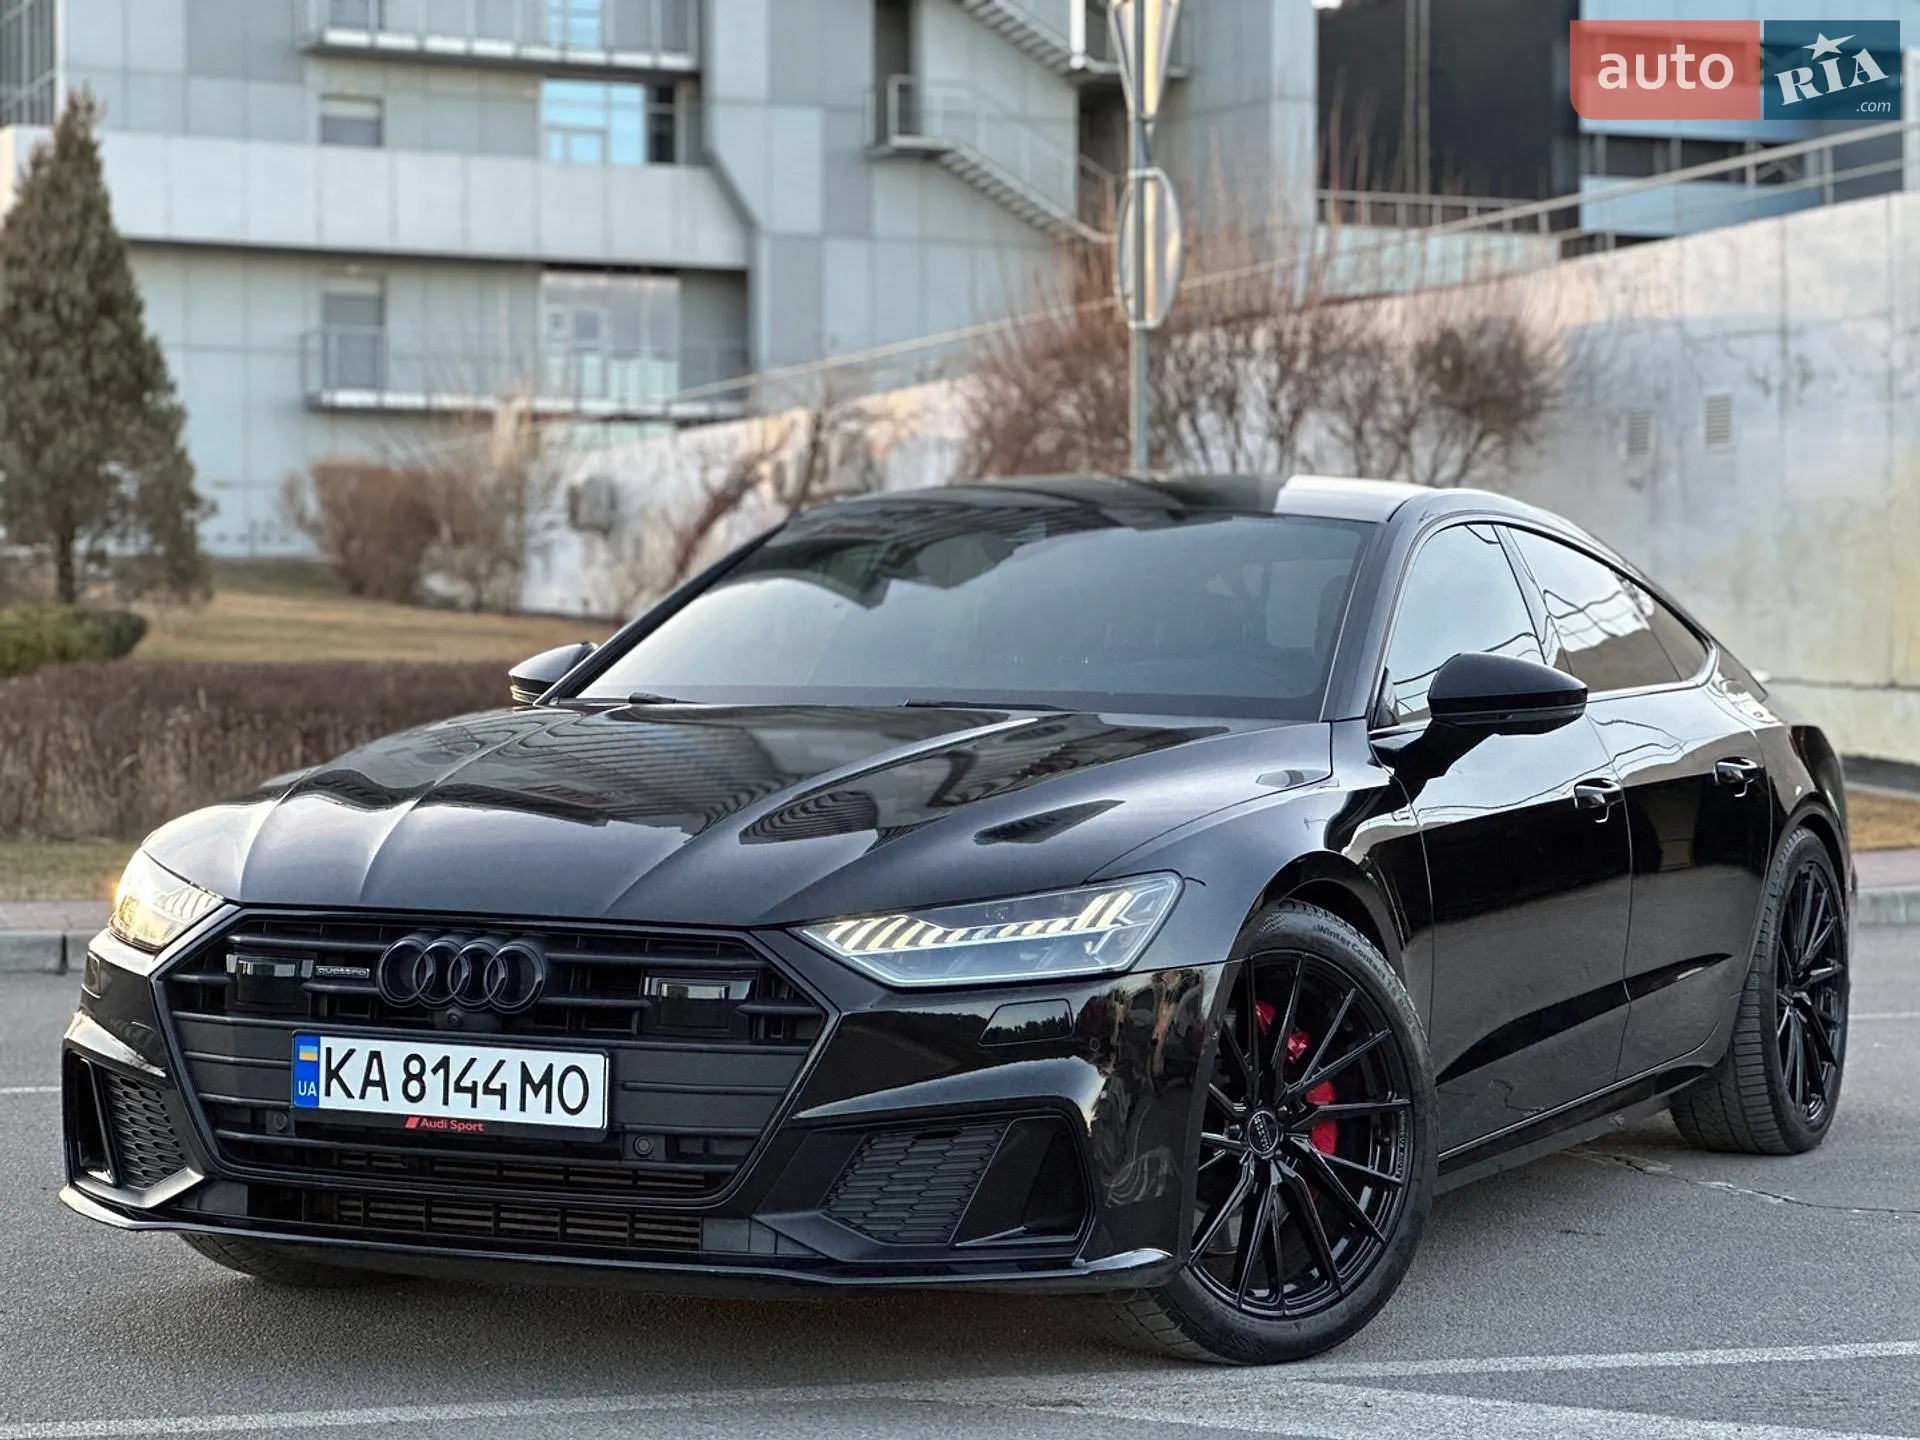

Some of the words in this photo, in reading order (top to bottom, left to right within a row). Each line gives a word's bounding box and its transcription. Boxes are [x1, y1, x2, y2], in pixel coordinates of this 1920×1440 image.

[298, 1080, 317, 1097] UA
[324, 1046, 390, 1102] KA
[402, 1053, 507, 1111] 8144
[519, 1061, 590, 1116] MO
[420, 1118, 448, 1130] Audi
[450, 1119, 485, 1132] Sport
